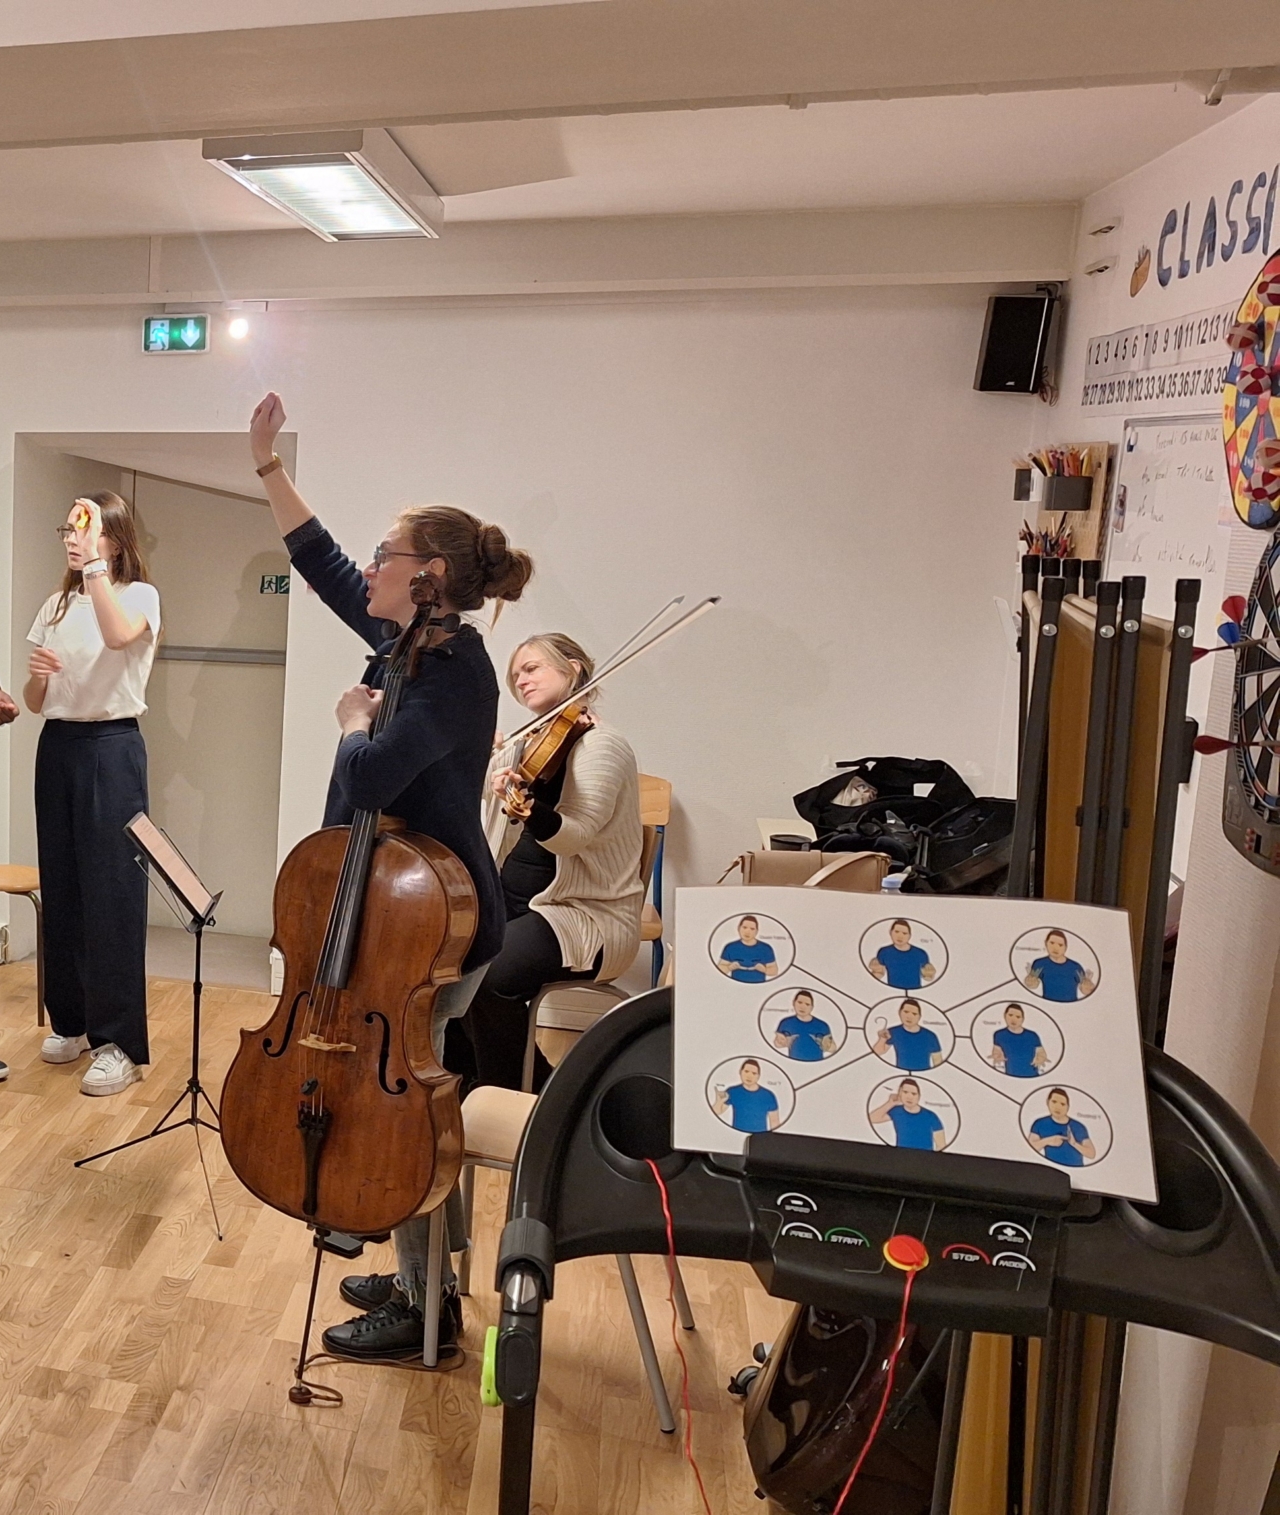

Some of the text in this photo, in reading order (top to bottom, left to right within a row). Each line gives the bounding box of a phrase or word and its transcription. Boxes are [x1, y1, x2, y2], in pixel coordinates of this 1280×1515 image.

[1087, 344, 1093, 365] 1
[1094, 342, 1101, 365] 2
[1104, 340, 1110, 363] 3
[1114, 339, 1120, 361] 4
[1122, 337, 1128, 361] 5
[1131, 335, 1138, 359] 6
[1143, 332, 1149, 356] 7
[1151, 330, 1159, 355] 8
[1162, 328, 1170, 353] 9
[1173, 324, 1184, 351] 10
[1184, 320, 1194, 348] 11
[1196, 317, 1209, 345] 12
[1209, 314, 1221, 342] 13
[1115, 381, 1125, 403] 30
[1134, 377, 1144, 401] 32
[1144, 376, 1155, 400] 33
[1156, 375, 1167, 400] 34
[1166, 372, 1177, 398] 35
[1178, 371, 1190, 397] 36
[1189, 369, 1202, 396] 37
[1201, 368, 1214, 395] 38
[830, 1234, 864, 1247] START
[997, 1234, 1024, 1243] SPEED
[952, 1252, 980, 1262] STOP
